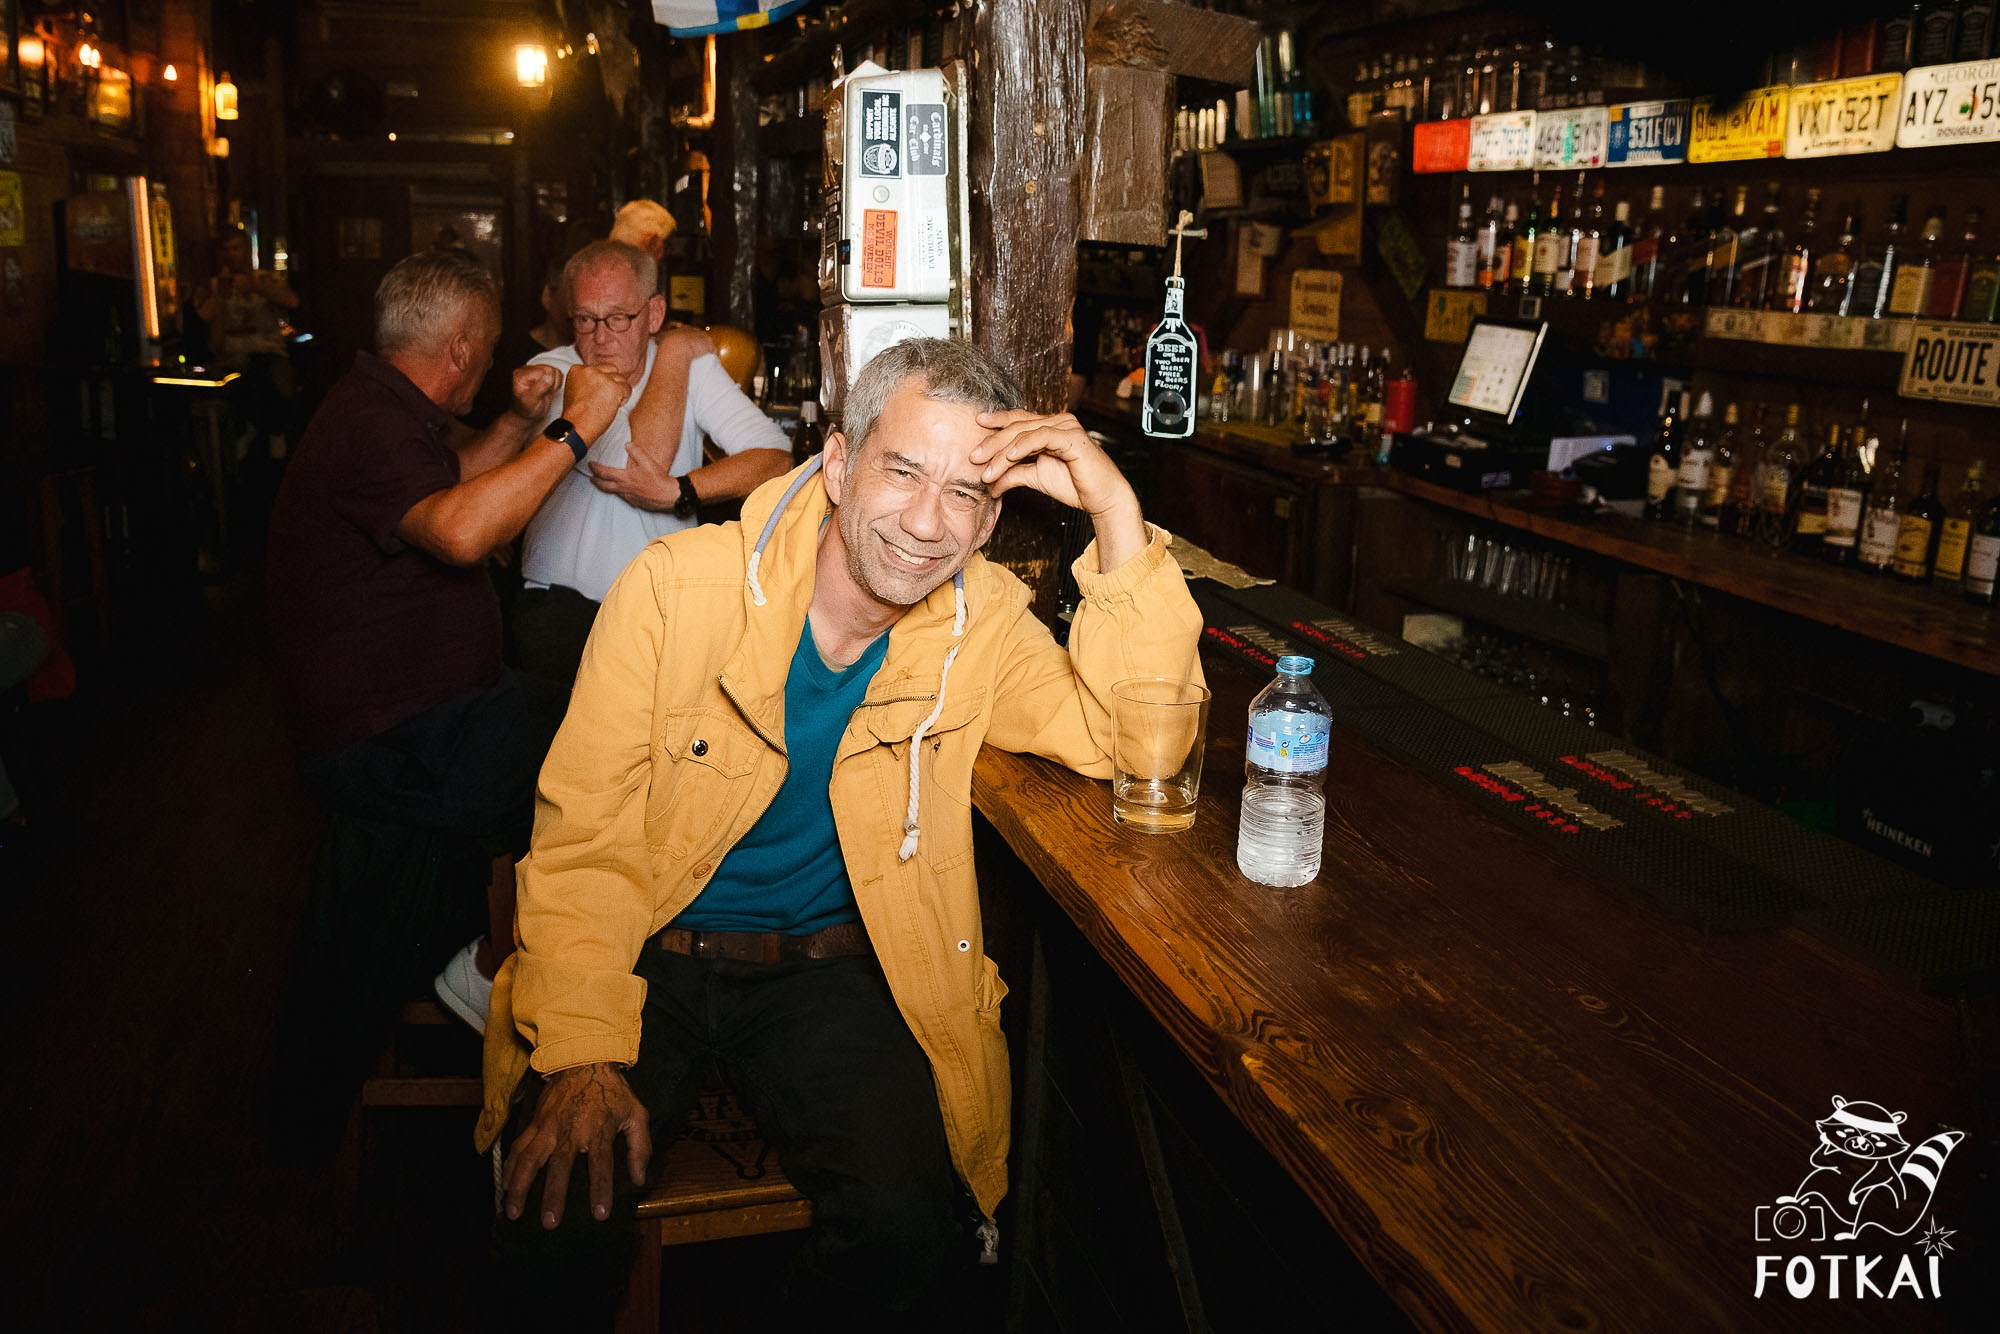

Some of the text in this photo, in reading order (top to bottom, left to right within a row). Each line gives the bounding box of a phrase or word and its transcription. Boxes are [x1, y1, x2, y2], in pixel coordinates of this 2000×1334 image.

[866, 107, 874, 140] SUPPORT
[889, 107, 897, 141] ALICANTE
[1797, 94, 1889, 137] VXT 52T
[1904, 80, 2000, 127] AYZ 15
[908, 115, 920, 162] Car Club
[930, 111, 943, 167] Cardinals
[1936, 125, 1985, 138] DOUGLAS
[873, 213, 886, 284] DEVIL DOLLS
[1157, 343, 1186, 353] BEER
[1910, 337, 1993, 386] ROUTE
[1154, 379, 1184, 393] FLOOR!
[1165, 376, 1189, 384] BEERS
[1866, 817, 1934, 858] HEINEKEN
